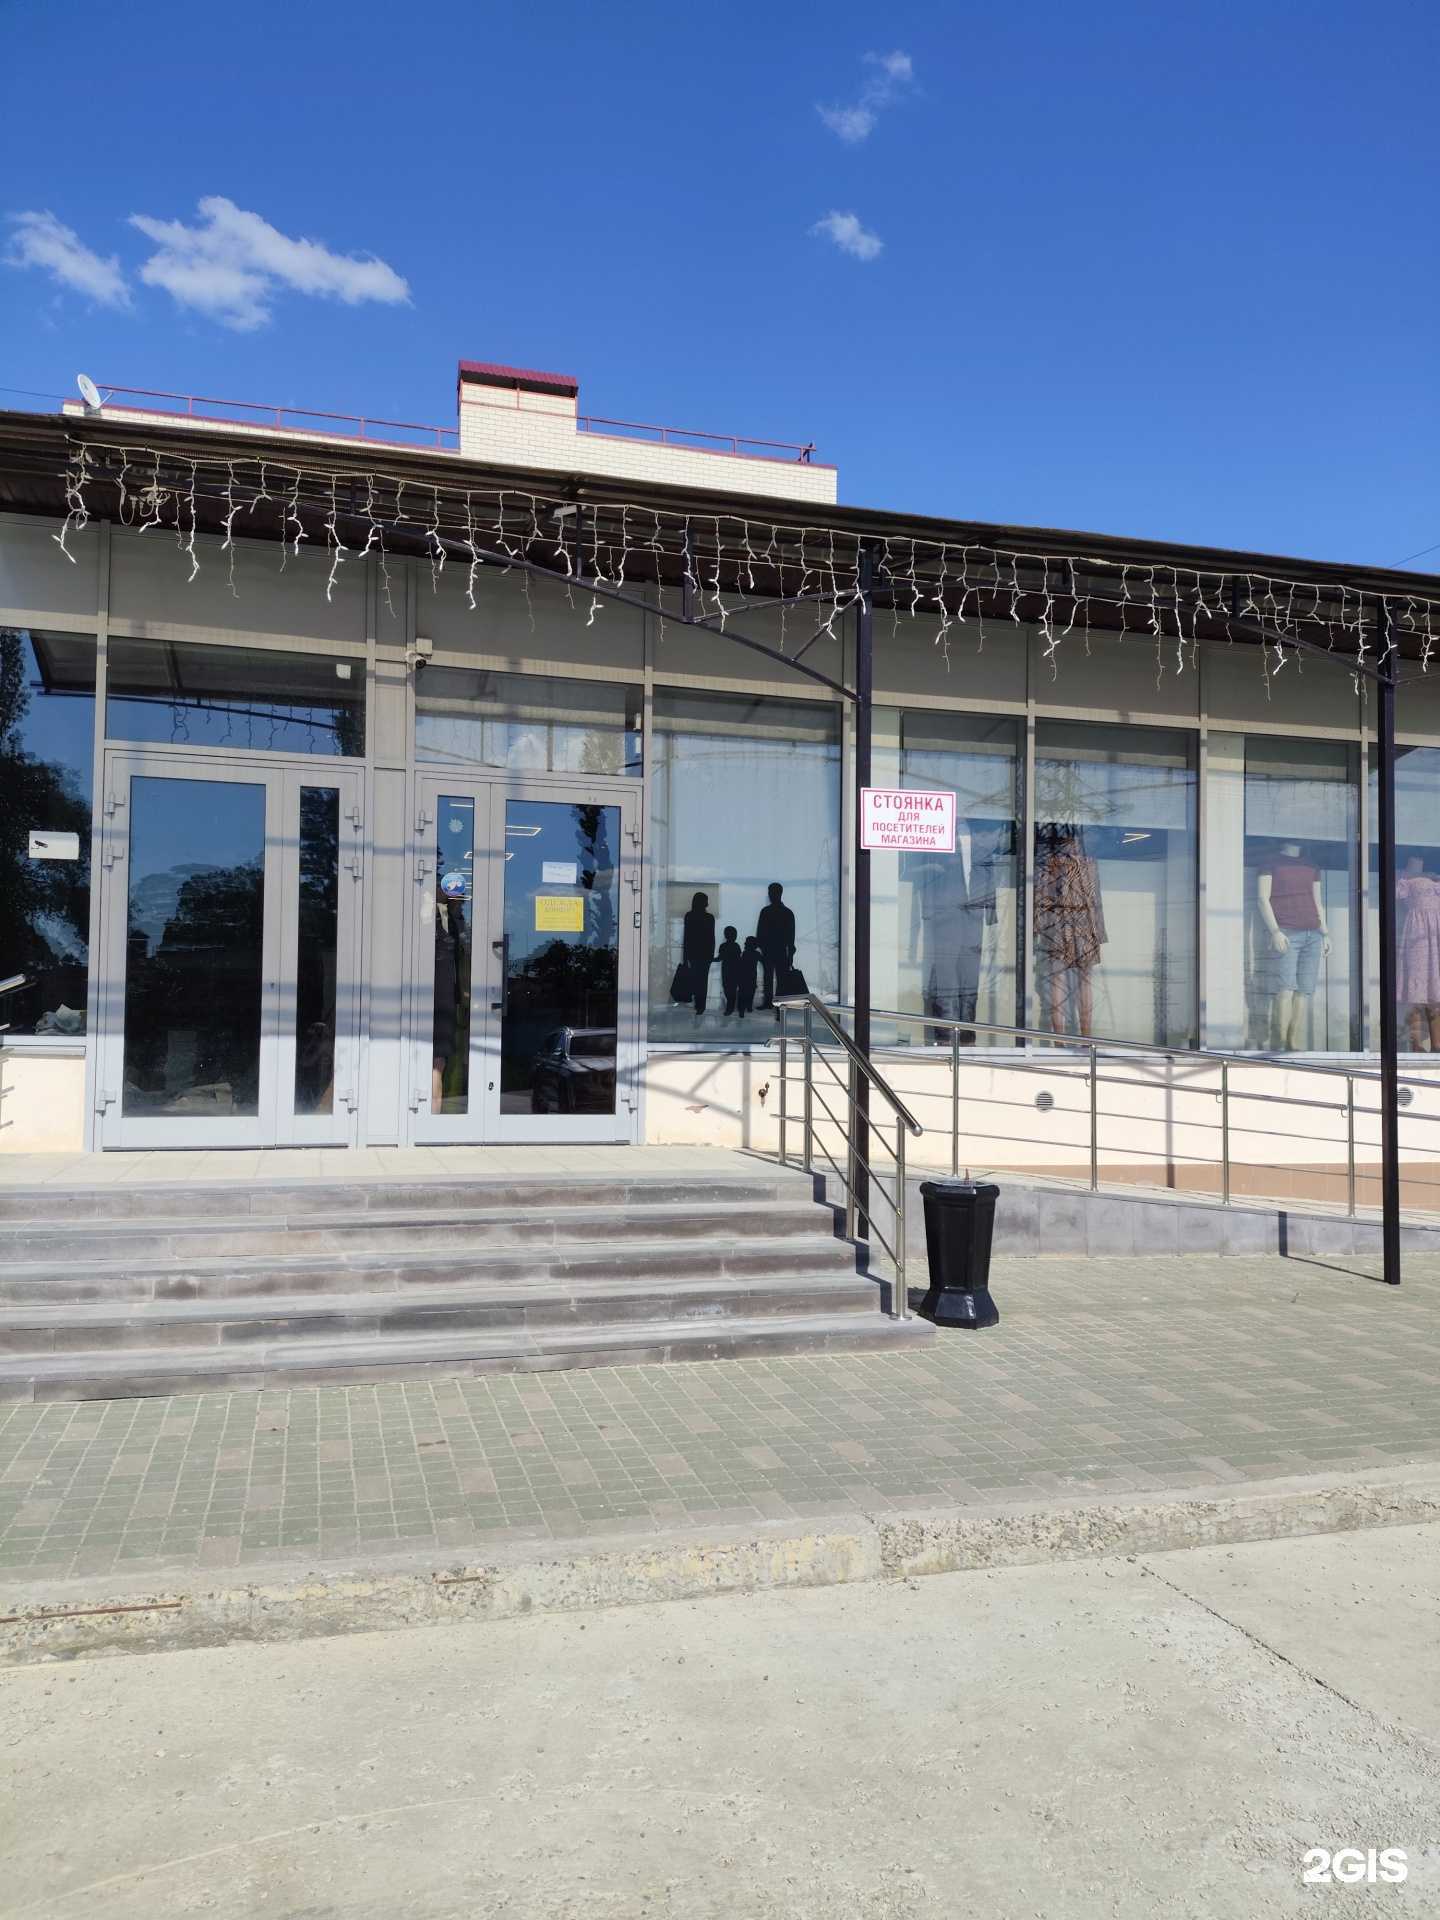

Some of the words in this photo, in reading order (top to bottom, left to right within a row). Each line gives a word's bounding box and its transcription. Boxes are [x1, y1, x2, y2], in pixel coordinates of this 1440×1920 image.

[873, 795, 944, 811] СТОЯНКА
[898, 812, 920, 822] ДЛЯ
[872, 822, 945, 834] ПОСЕТИТЕЛЕЙ
[881, 835, 936, 846] МАГАЗИНА
